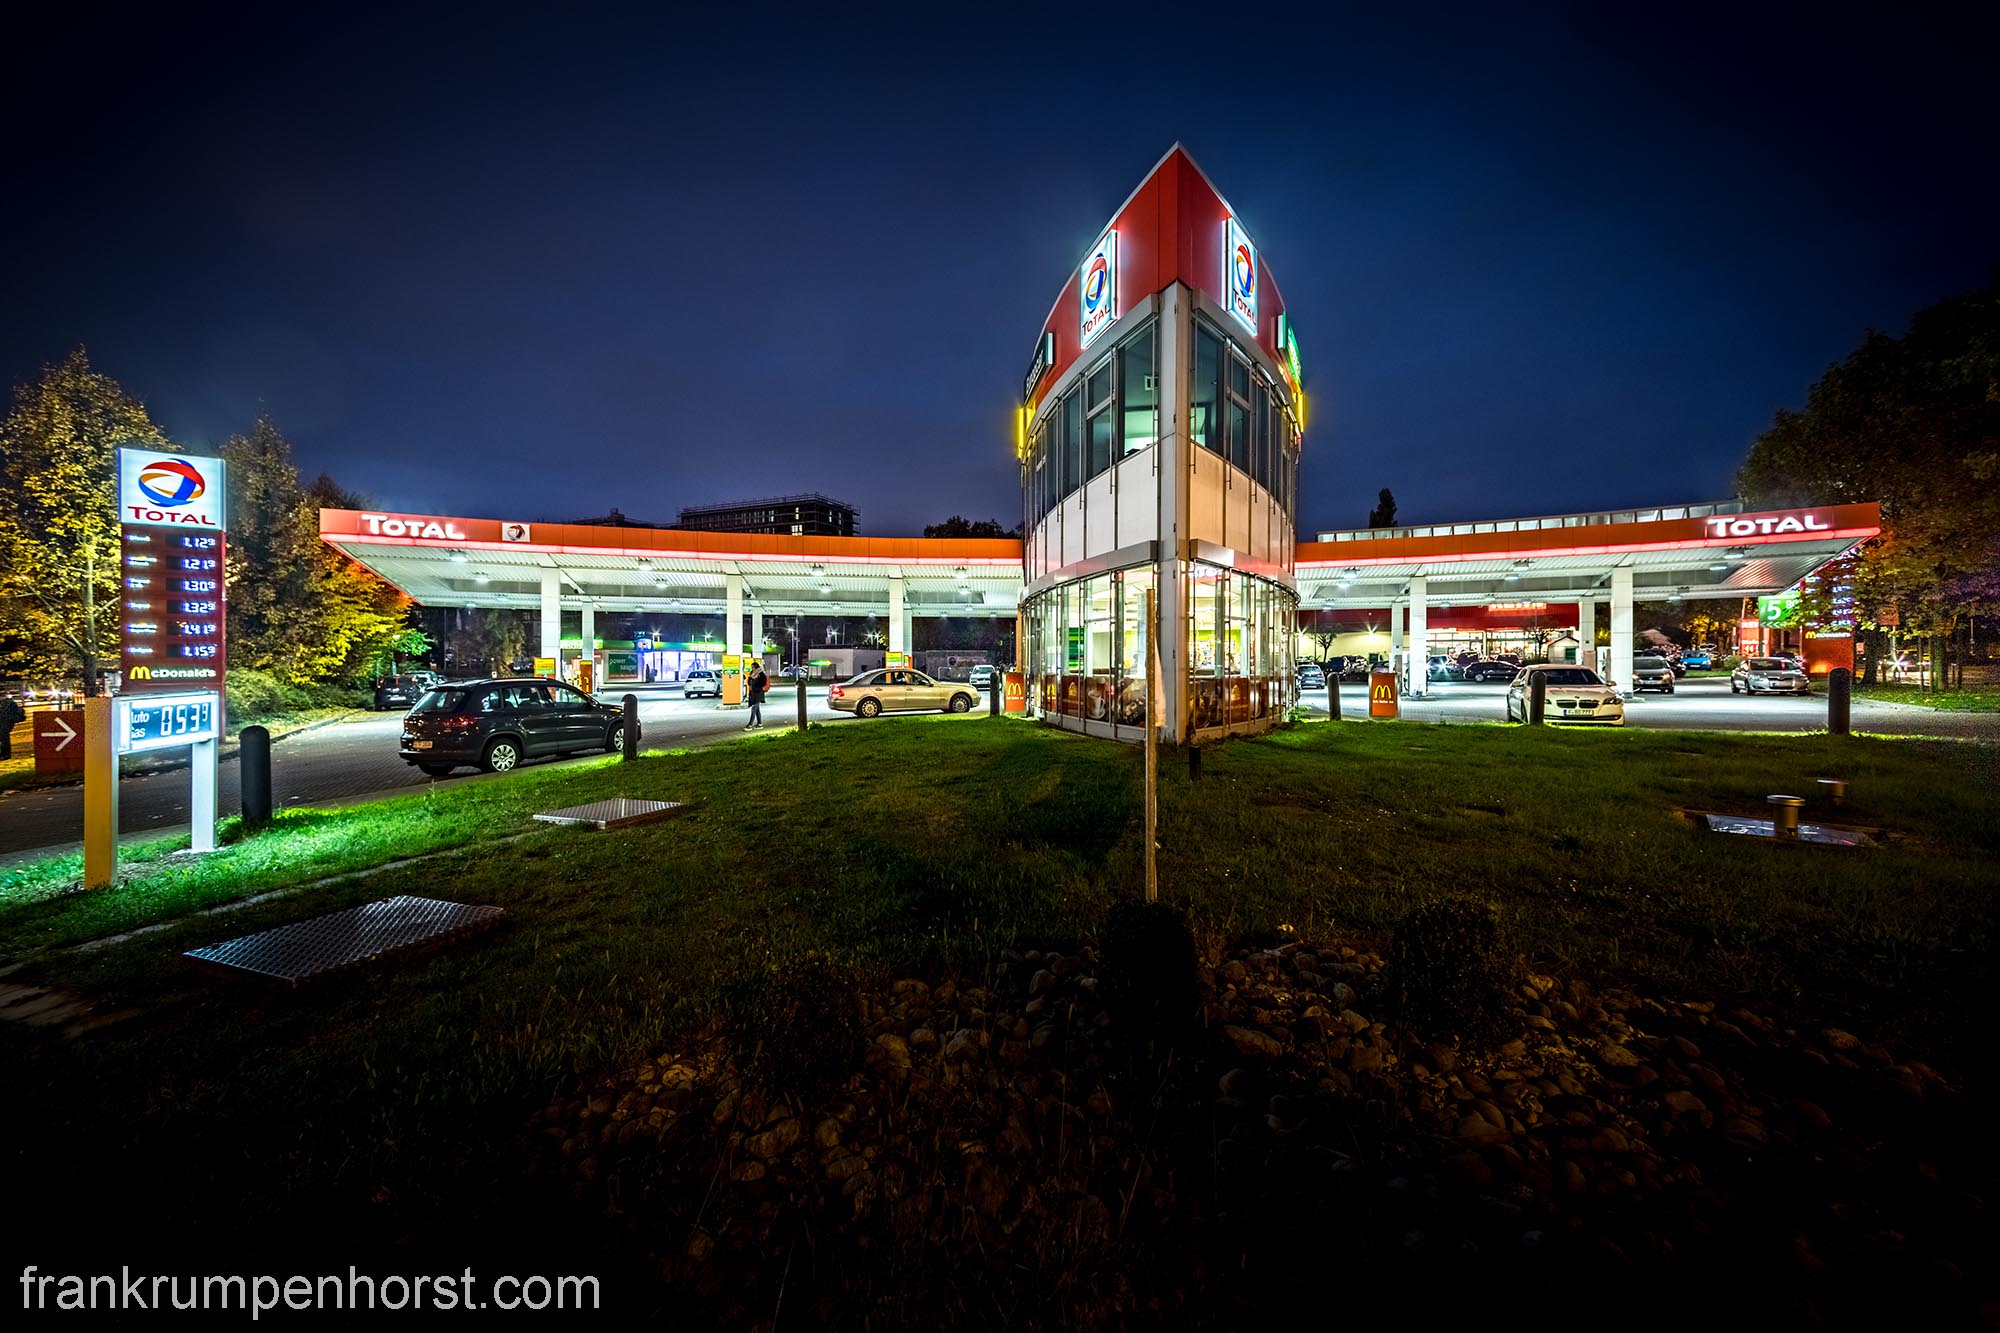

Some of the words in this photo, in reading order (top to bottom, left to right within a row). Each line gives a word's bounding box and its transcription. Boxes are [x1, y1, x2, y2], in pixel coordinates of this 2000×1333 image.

[1233, 287, 1257, 327] TOTAL
[1082, 304, 1111, 336] TOTAL
[128, 505, 216, 526] TOTAL
[361, 513, 465, 540] TOTAL
[1706, 514, 1829, 538] TOTAL
[129, 665, 217, 680] McDonald's
